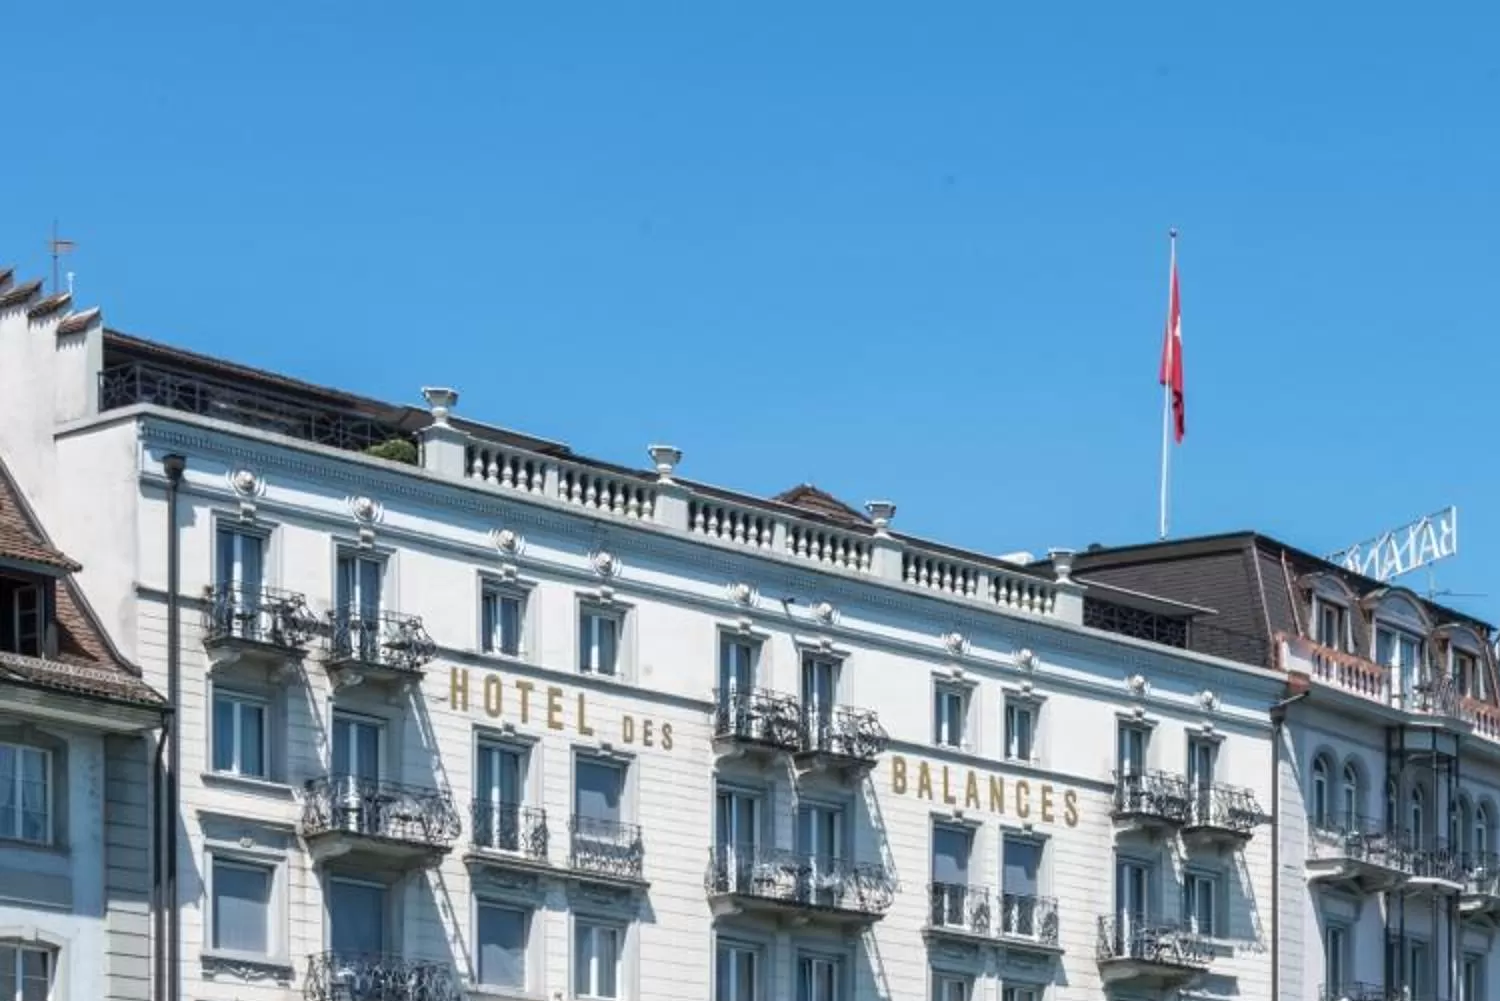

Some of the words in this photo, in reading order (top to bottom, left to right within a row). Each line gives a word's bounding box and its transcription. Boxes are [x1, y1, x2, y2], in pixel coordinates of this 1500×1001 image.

[450, 667, 594, 736] HOTEL
[623, 715, 673, 750] DES
[892, 755, 1079, 827] BALANCES
